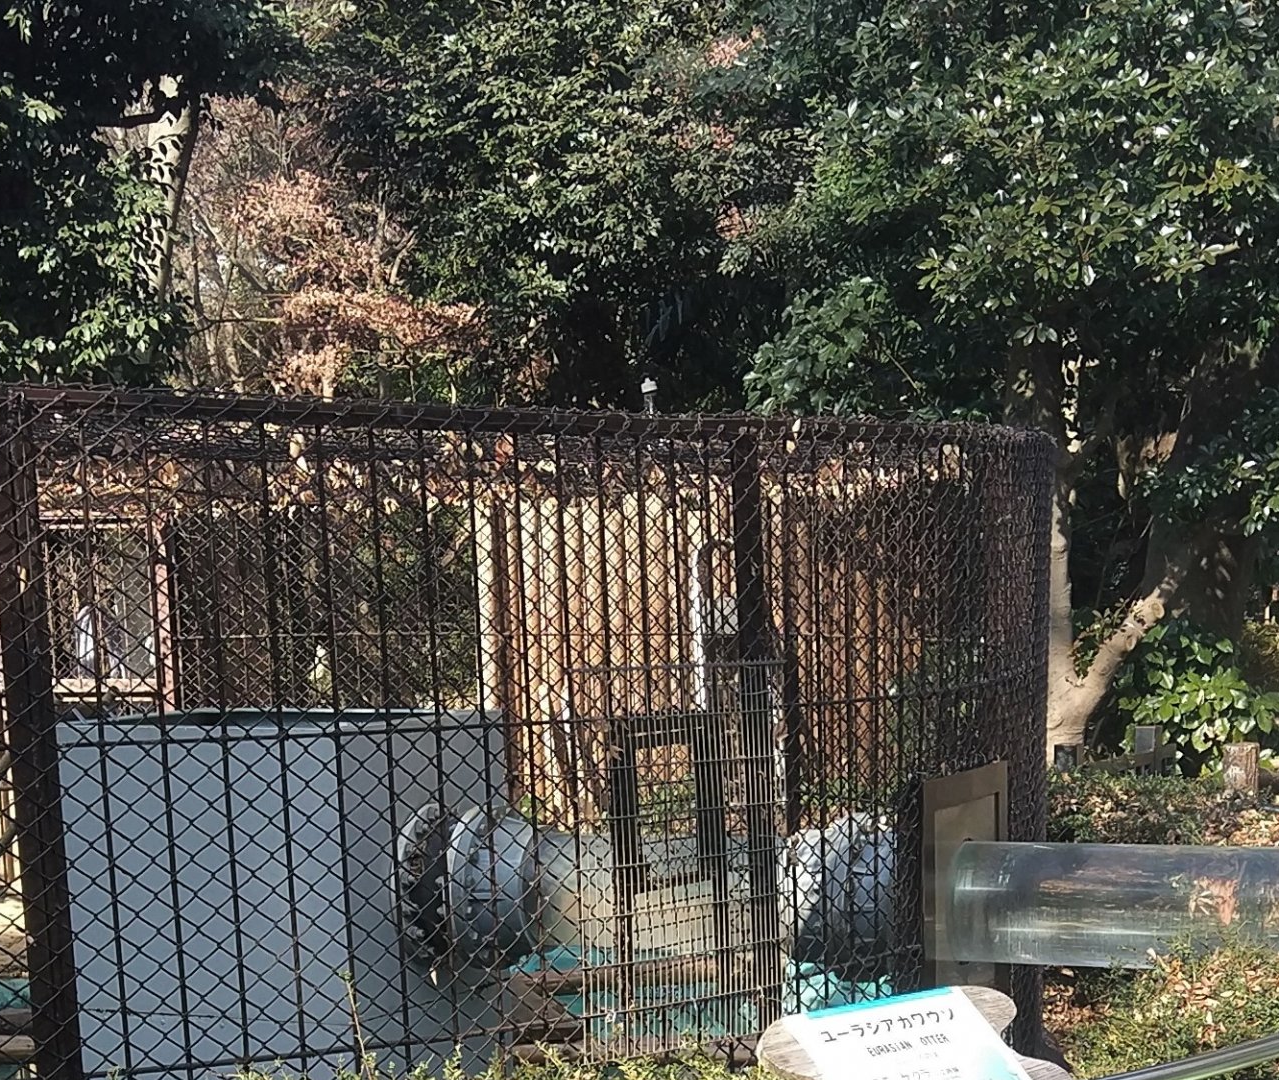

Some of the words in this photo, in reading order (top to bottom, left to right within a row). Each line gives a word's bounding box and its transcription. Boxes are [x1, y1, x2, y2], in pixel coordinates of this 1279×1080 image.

[820, 1008, 954, 1043] ユーラシアカワウソ
[866, 1040, 913, 1057] EURASIAN
[920, 1033, 950, 1046] OTTER
